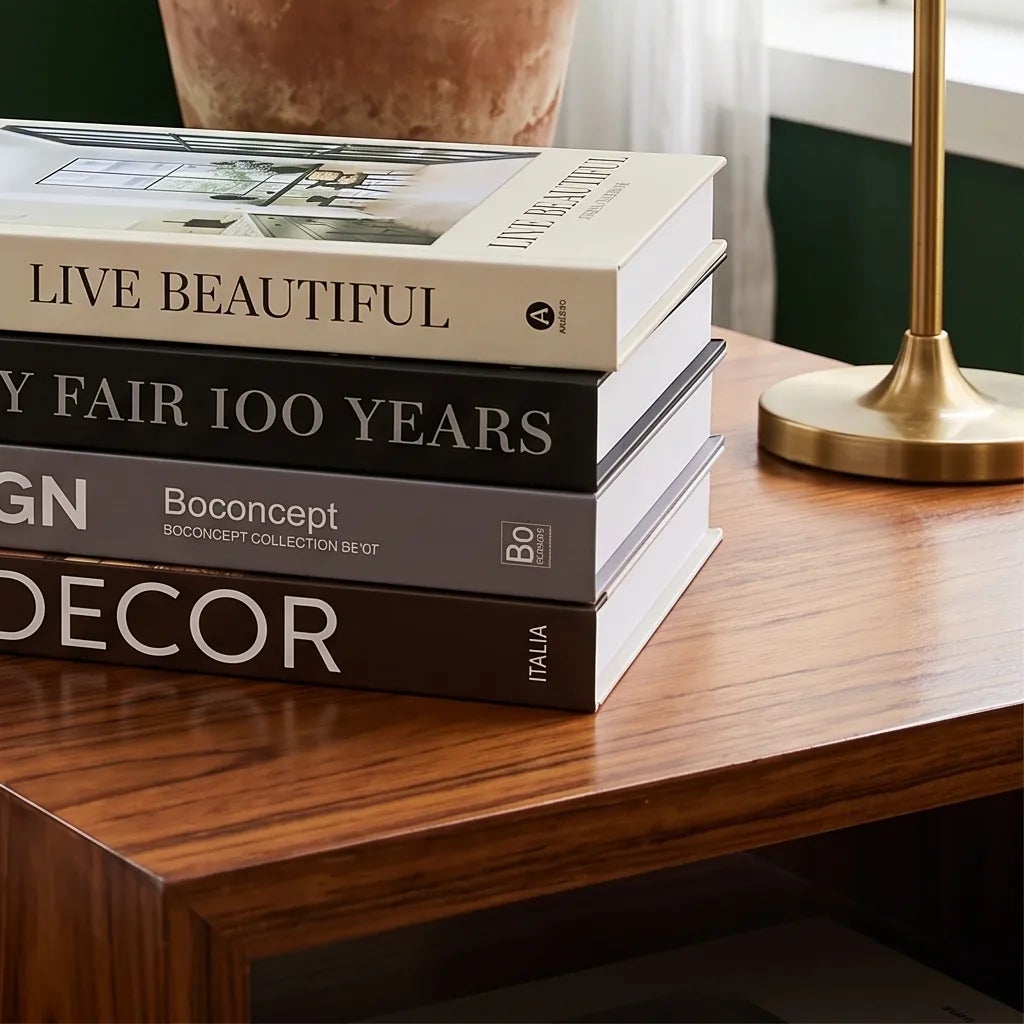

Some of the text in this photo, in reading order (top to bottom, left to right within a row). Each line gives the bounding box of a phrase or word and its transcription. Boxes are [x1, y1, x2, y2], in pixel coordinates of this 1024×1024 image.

[523, 156, 630, 218] BEAUTIFUL
[29, 263, 451, 329] LIVE BEAUTIFUL
[53, 374, 190, 428] FAIR
[343, 396, 553, 457] YEARS
[163, 486, 339, 535] Boconcept
[163, 524, 249, 543] BOCONCEPT
[250, 532, 338, 552] COLLECTION
[528, 624, 548, 683] ITALIA
